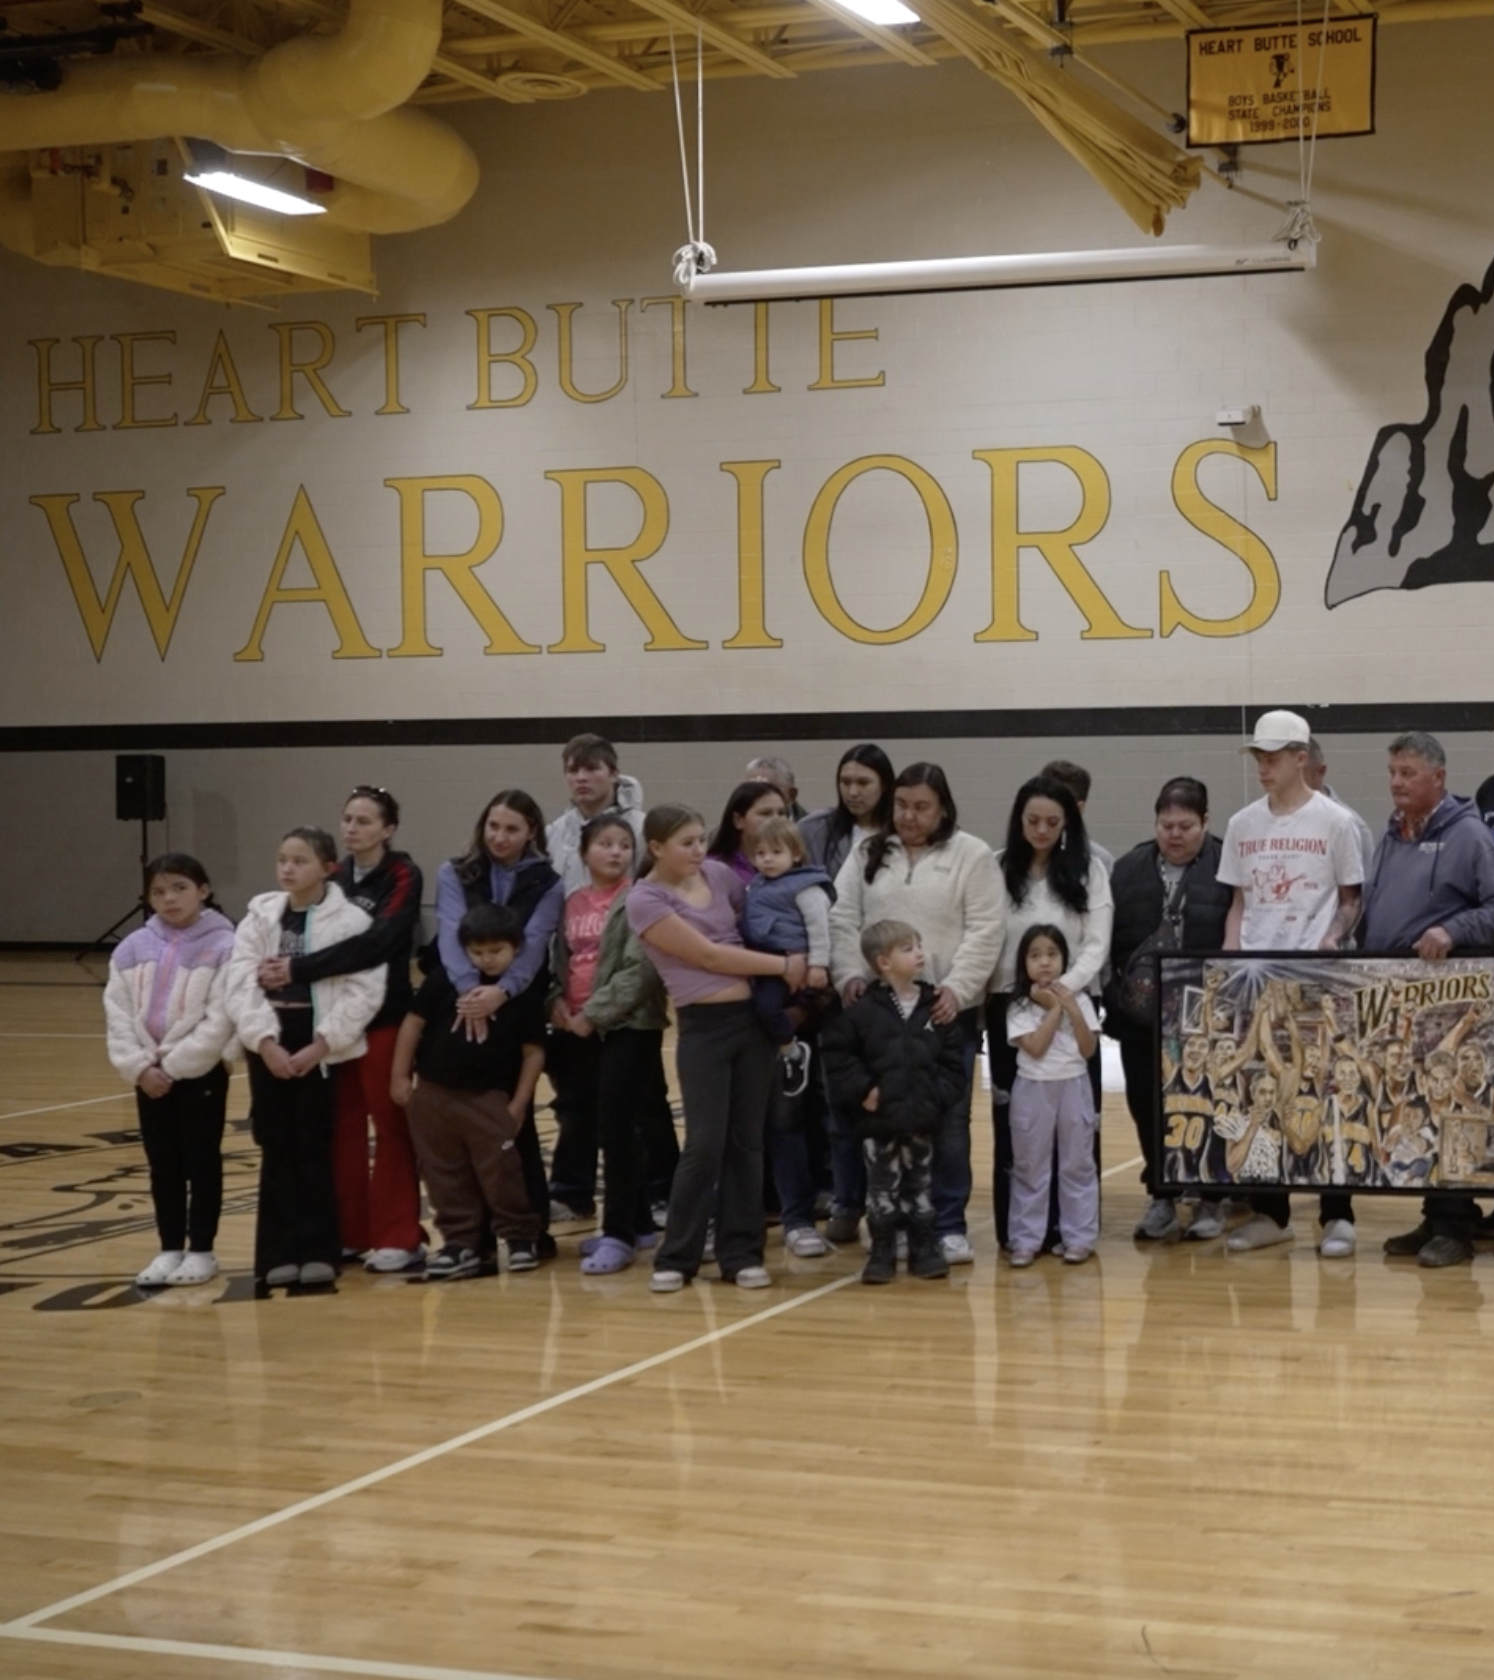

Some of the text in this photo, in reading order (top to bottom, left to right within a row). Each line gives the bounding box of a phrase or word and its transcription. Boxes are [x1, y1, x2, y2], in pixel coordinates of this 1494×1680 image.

[1199, 29, 1361, 56] HEART BUTTE SCHOOL
[1228, 88, 1331, 107] BOYS BASKEBALL
[1228, 108, 1259, 121] STATE
[28, 295, 886, 434] HEART BUTTE
[28, 437, 1282, 664] WARRIORS
[1239, 837, 1327, 858] TRUE RELIGION
[1164, 1114, 1205, 1149] 30
